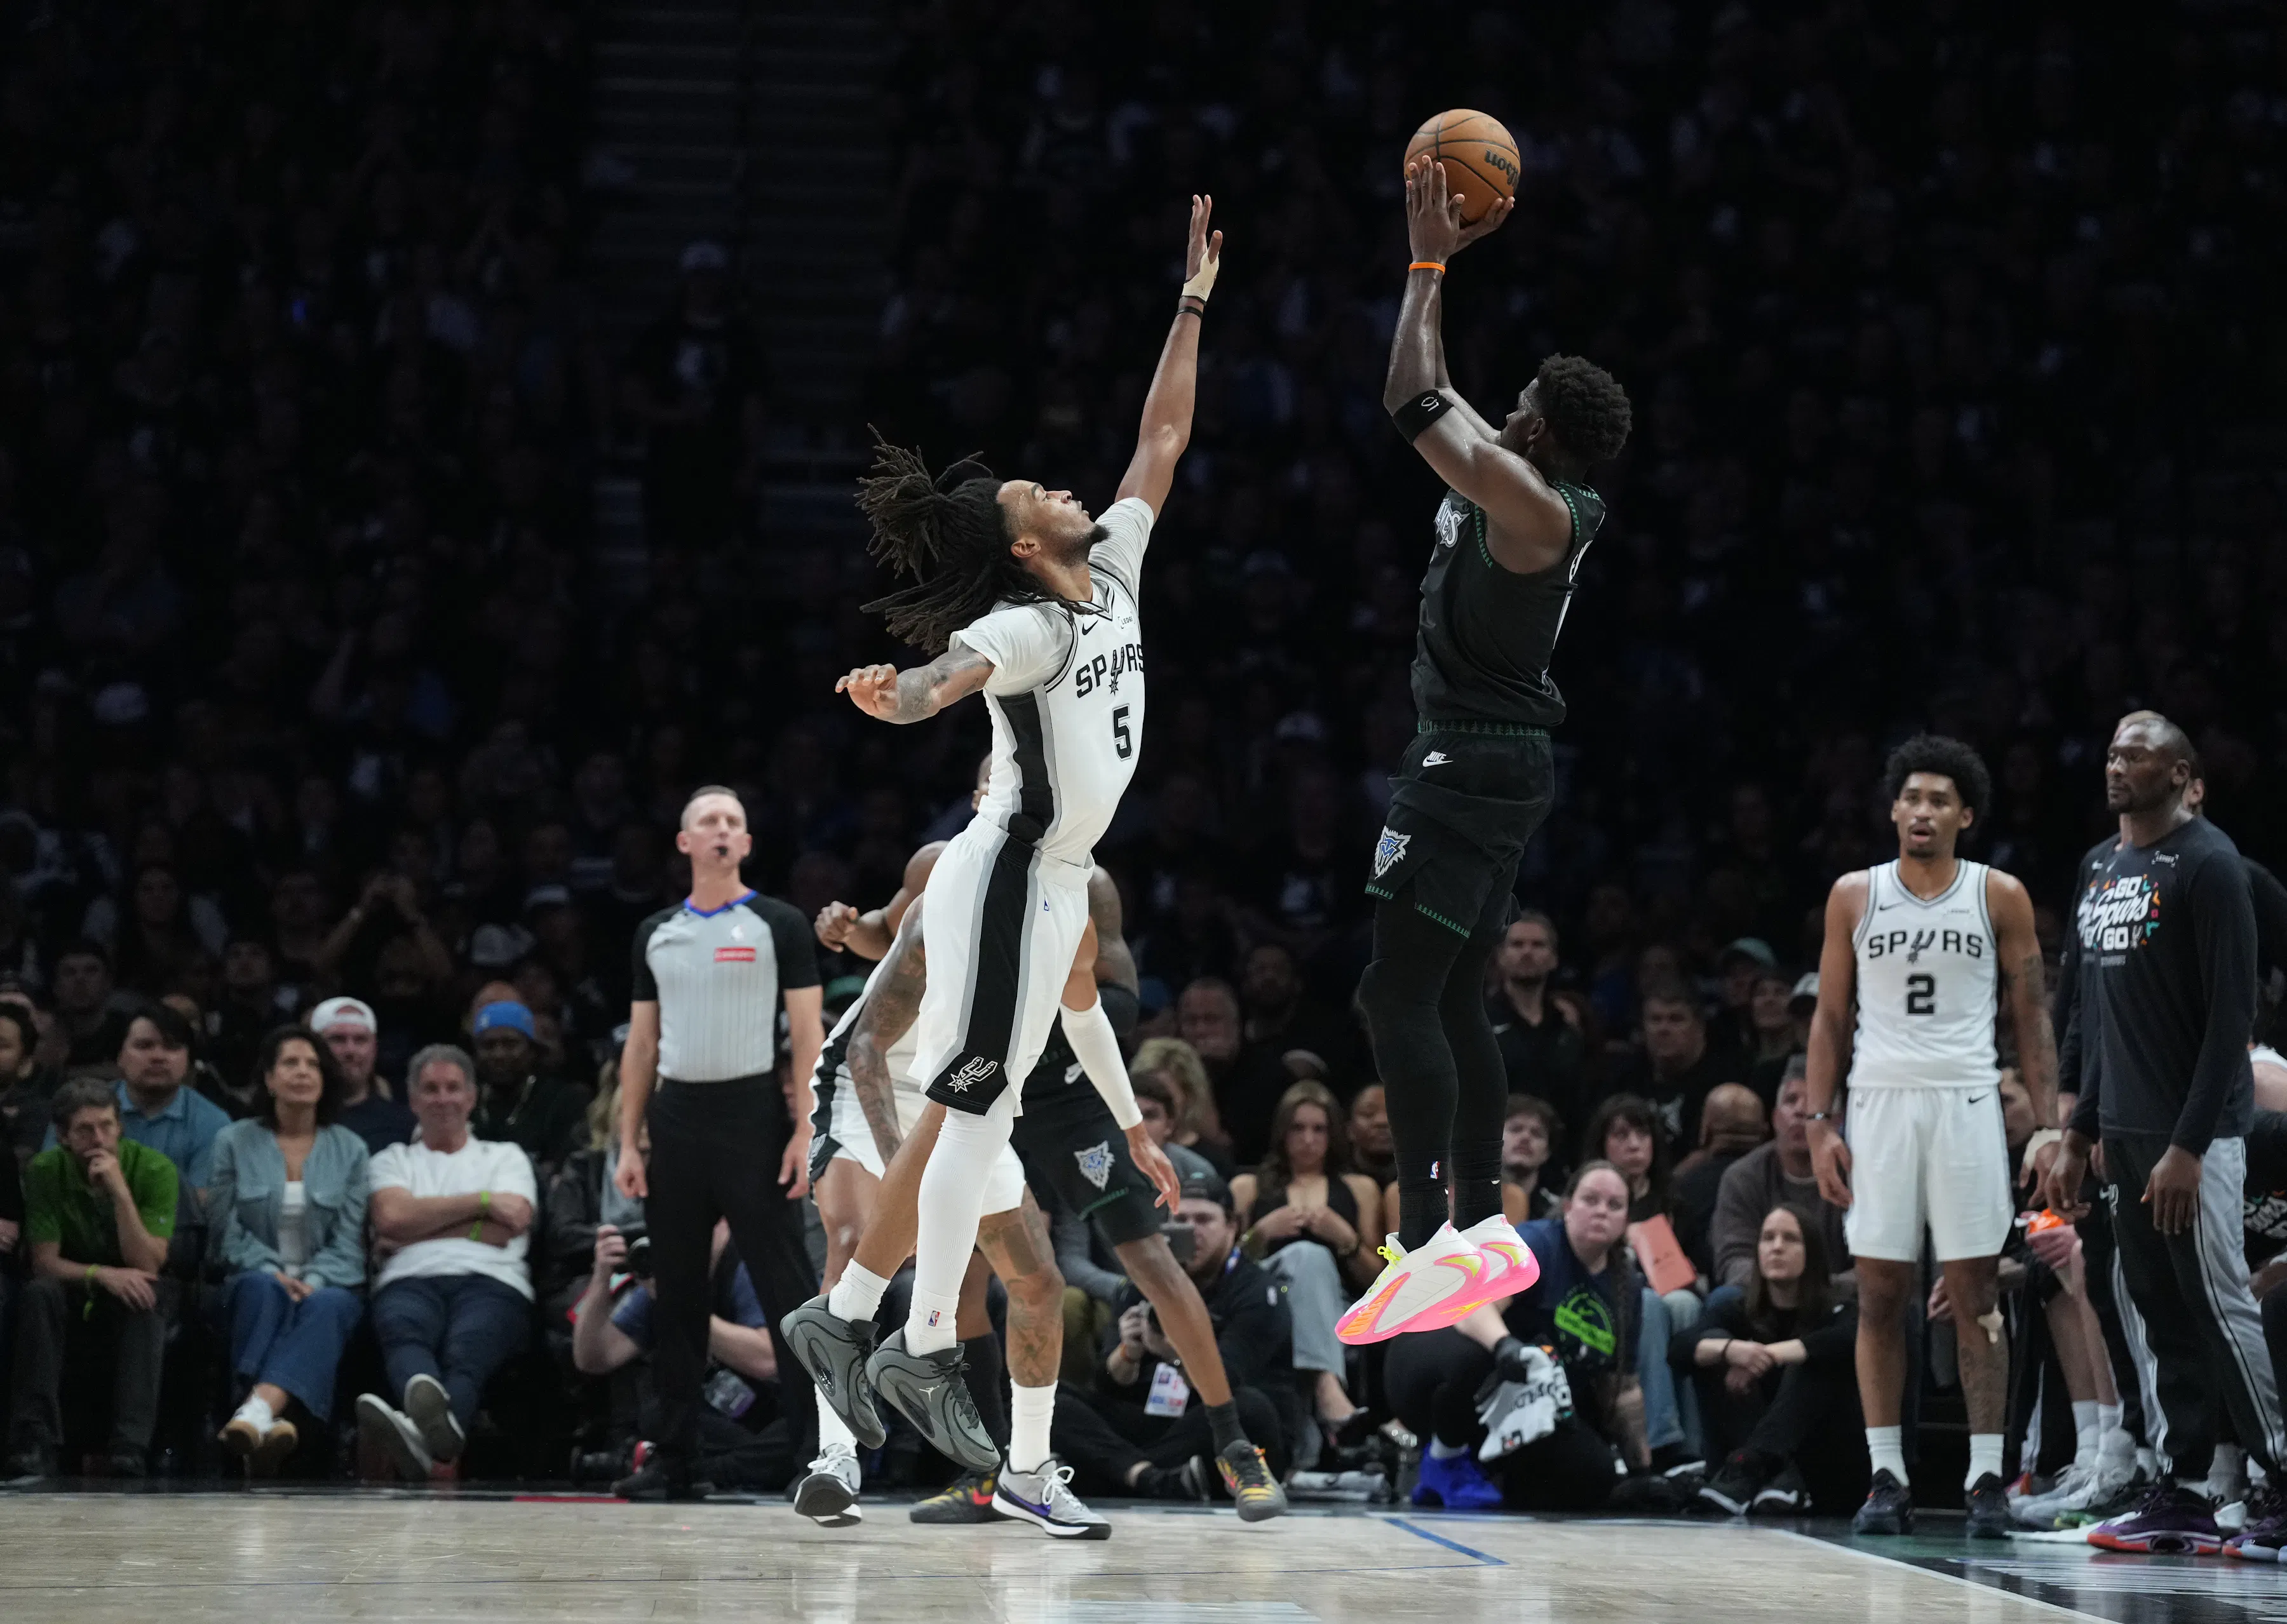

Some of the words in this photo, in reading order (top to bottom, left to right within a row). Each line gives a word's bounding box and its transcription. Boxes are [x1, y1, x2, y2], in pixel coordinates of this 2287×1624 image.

[1076, 643, 1144, 698] SPURS
[1112, 703, 1133, 762] 5
[1427, 750, 1447, 762] NIKE
[2113, 876, 2143, 899] GO
[2092, 887, 2152, 943] Spurs
[1868, 928, 1983, 965] SPURS
[2102, 926, 2129, 951] GO
[1906, 974, 1935, 1016] 2
